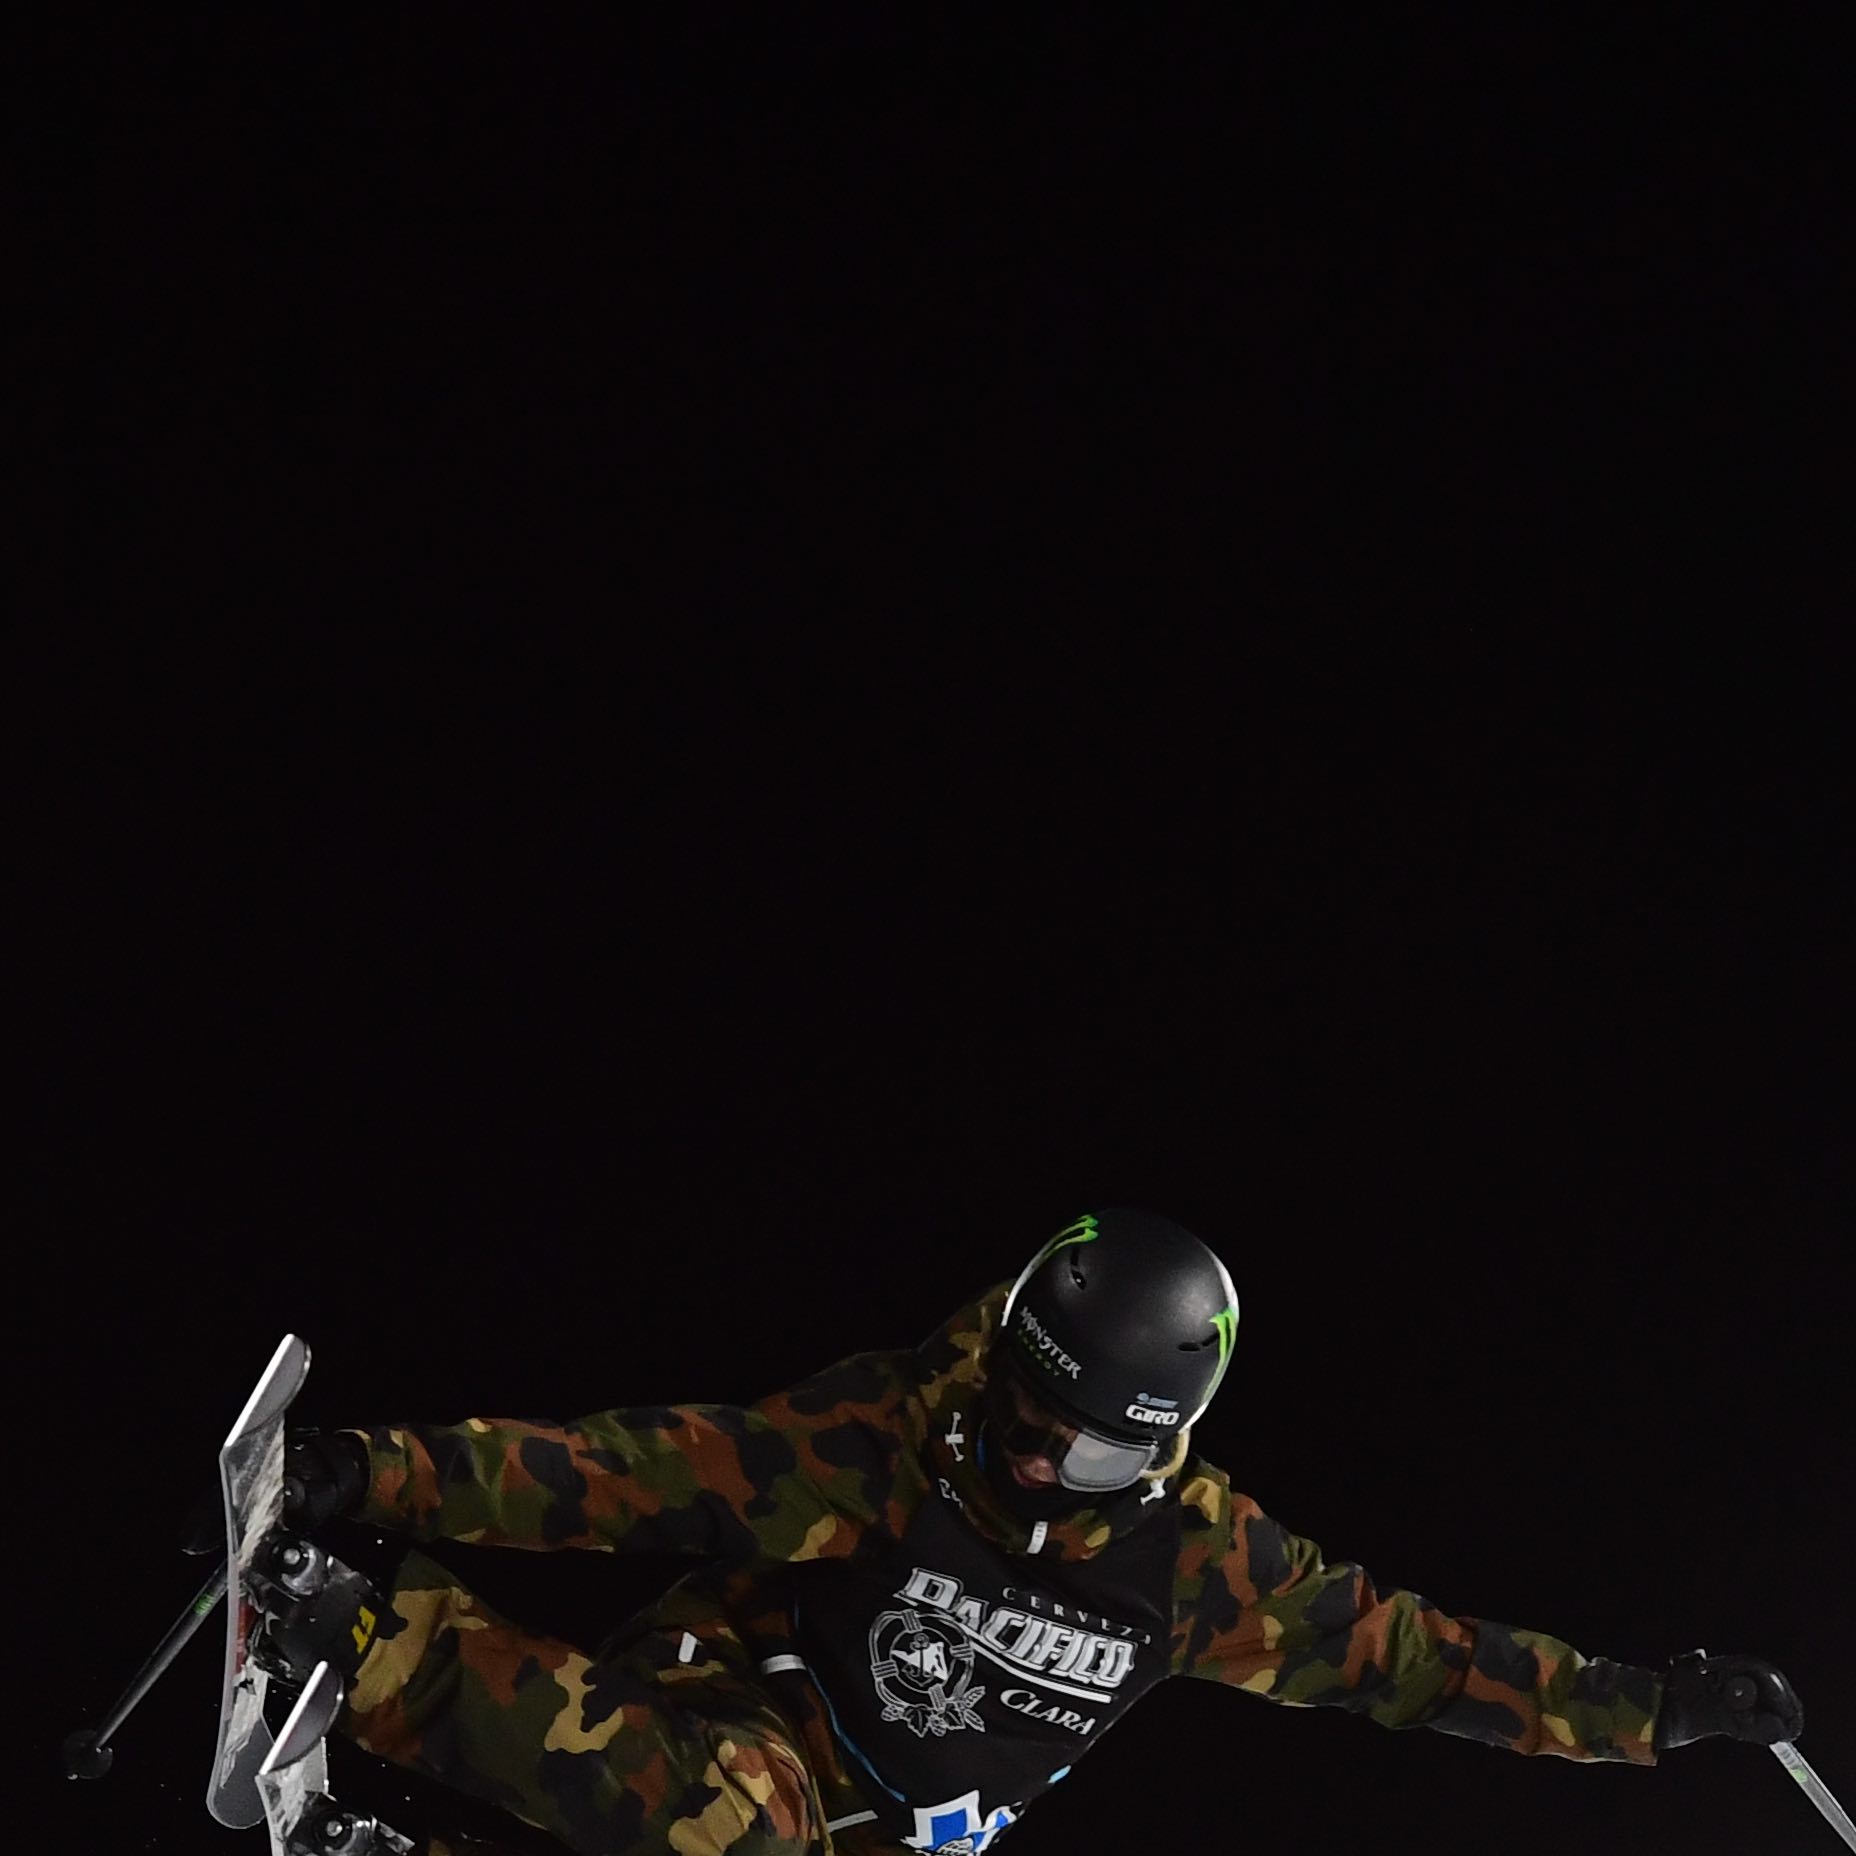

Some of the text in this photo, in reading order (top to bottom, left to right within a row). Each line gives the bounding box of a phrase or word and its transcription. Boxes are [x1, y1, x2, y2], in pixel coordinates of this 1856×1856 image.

[1020, 1306, 1082, 1379] MONSTER
[1125, 1404, 1180, 1425] GIRO
[893, 1567, 1139, 1689] PACIFICO
[1000, 1689, 1096, 1736] CLARA
